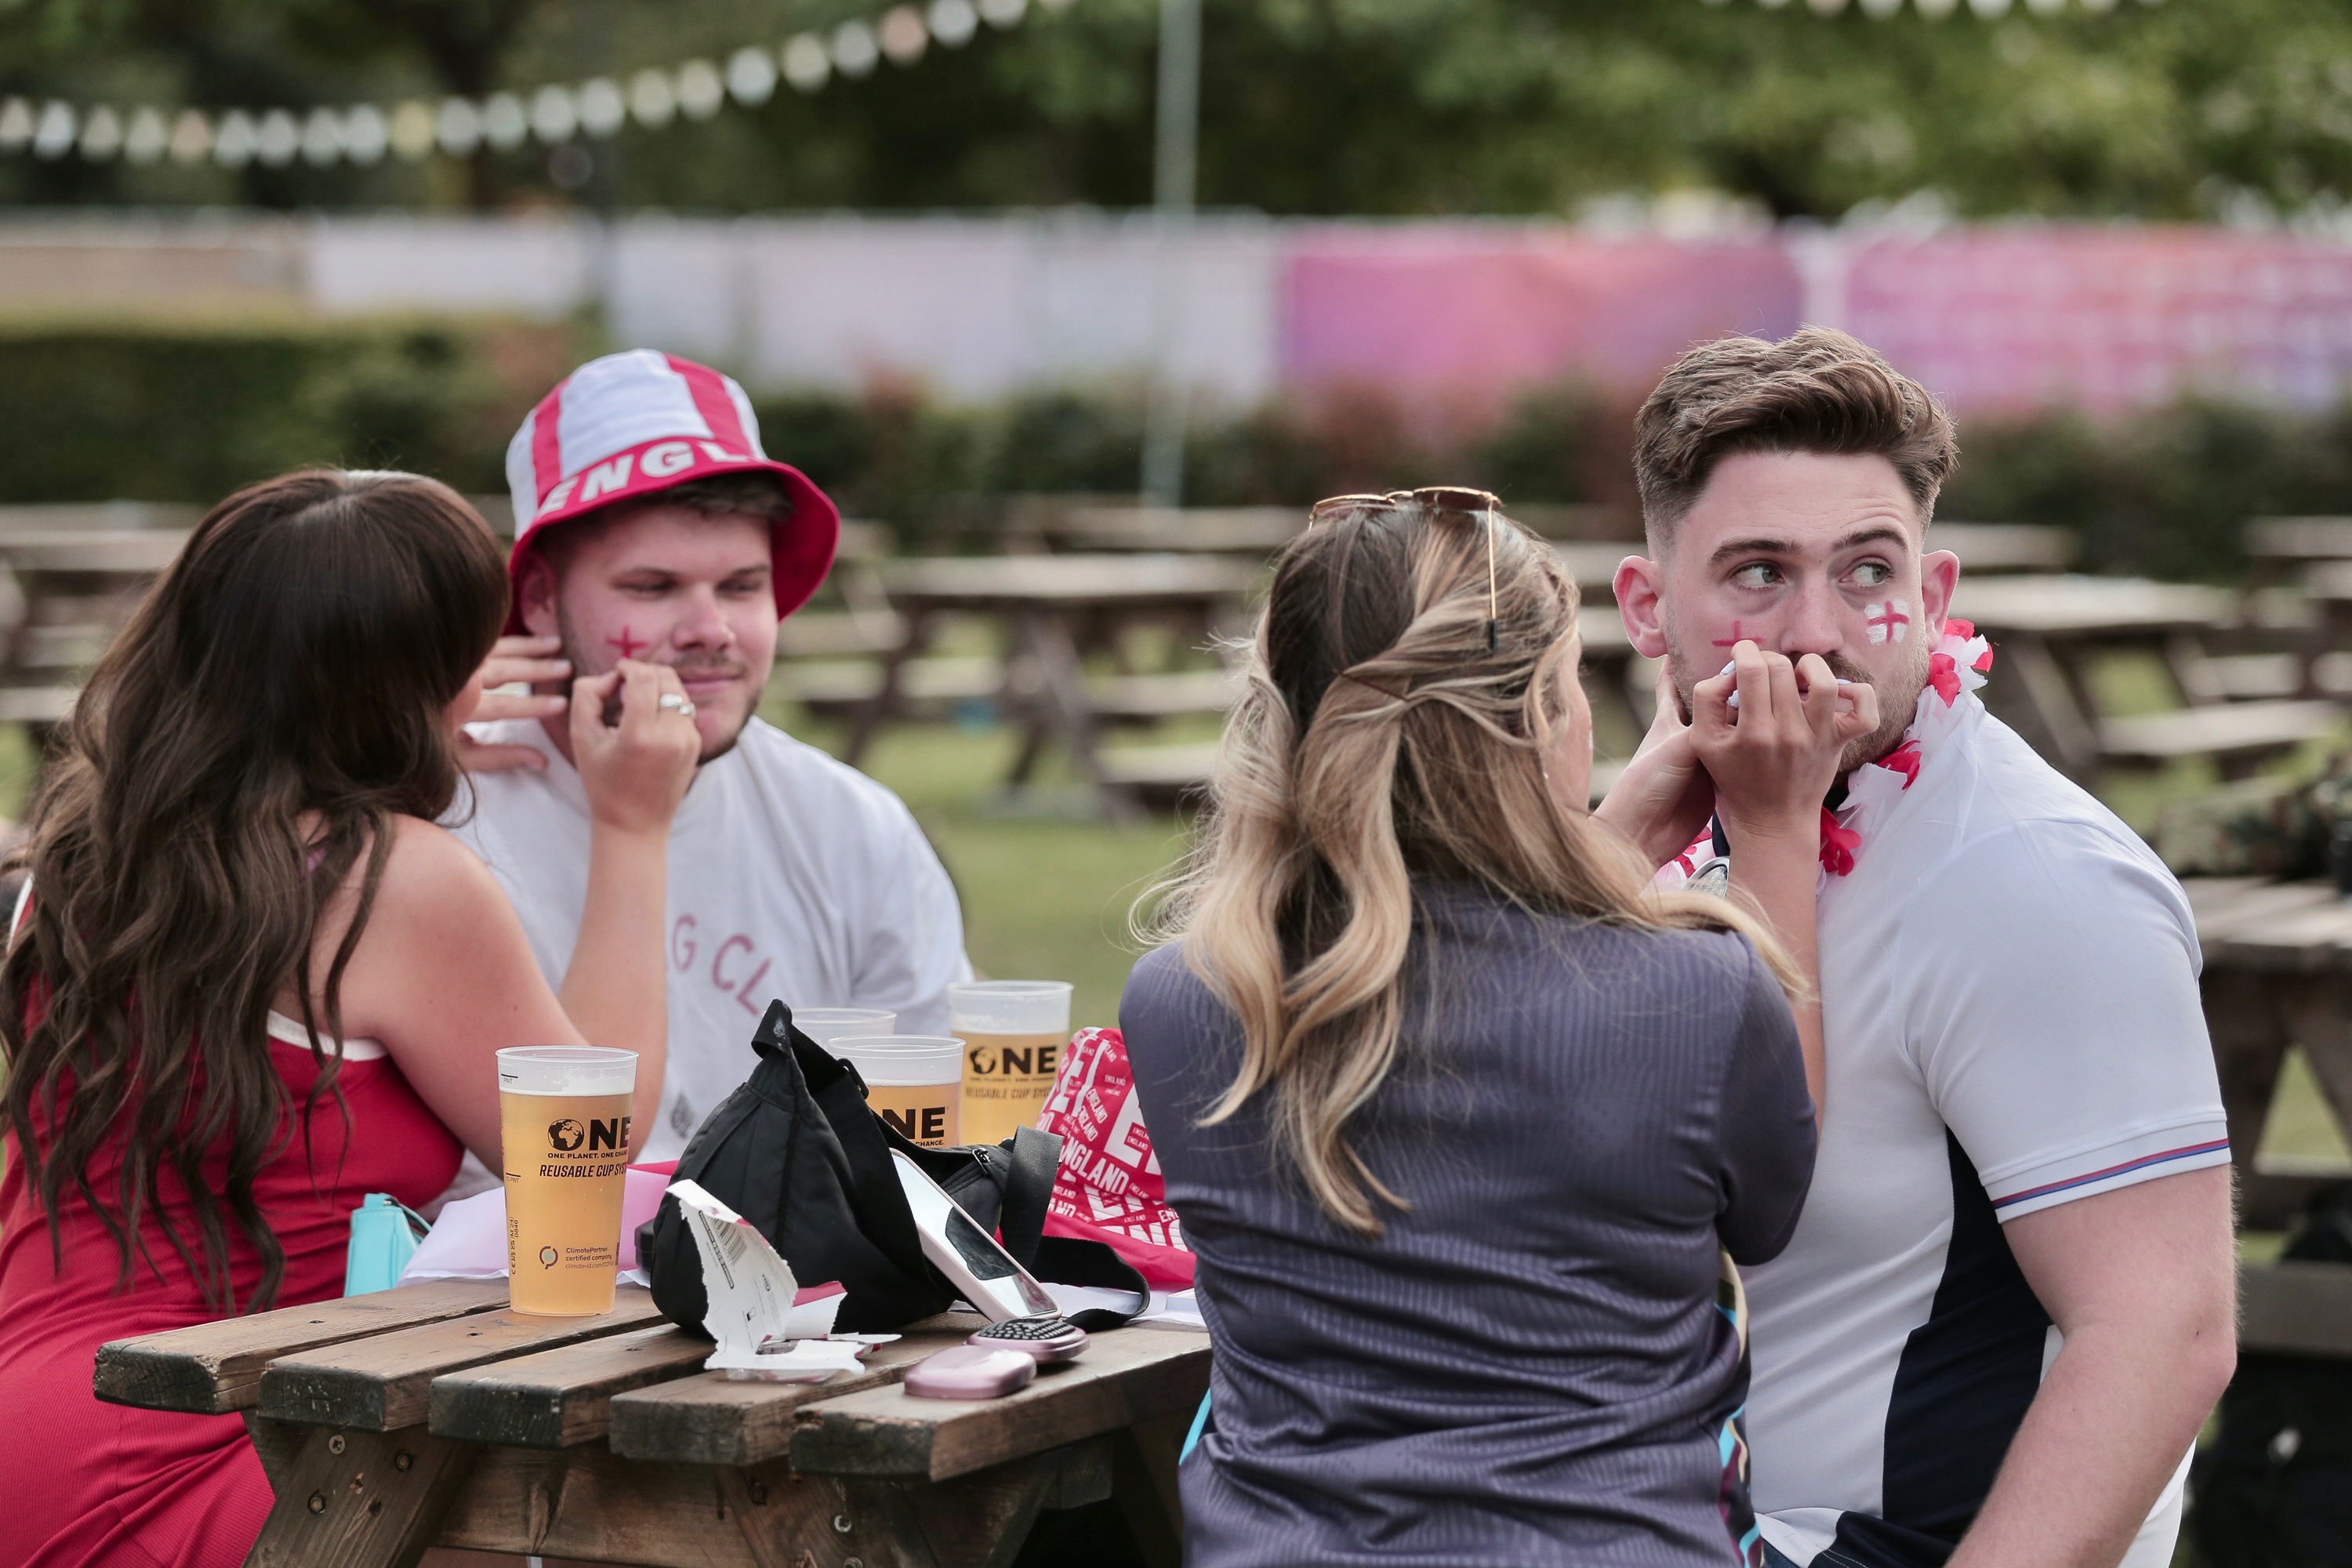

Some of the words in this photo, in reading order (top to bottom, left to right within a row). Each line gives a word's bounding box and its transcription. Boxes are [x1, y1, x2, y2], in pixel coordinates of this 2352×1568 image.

[1104, 1074, 1127, 1087] ENGLAND
[1085, 1088, 1108, 1124] ENGLAND
[1127, 1135, 1149, 1151] ENGLAND
[539, 1164, 595, 1178] REUSABLE
[596, 1163, 615, 1177] CUP
[1128, 1182, 1149, 1200] ENGLAND
